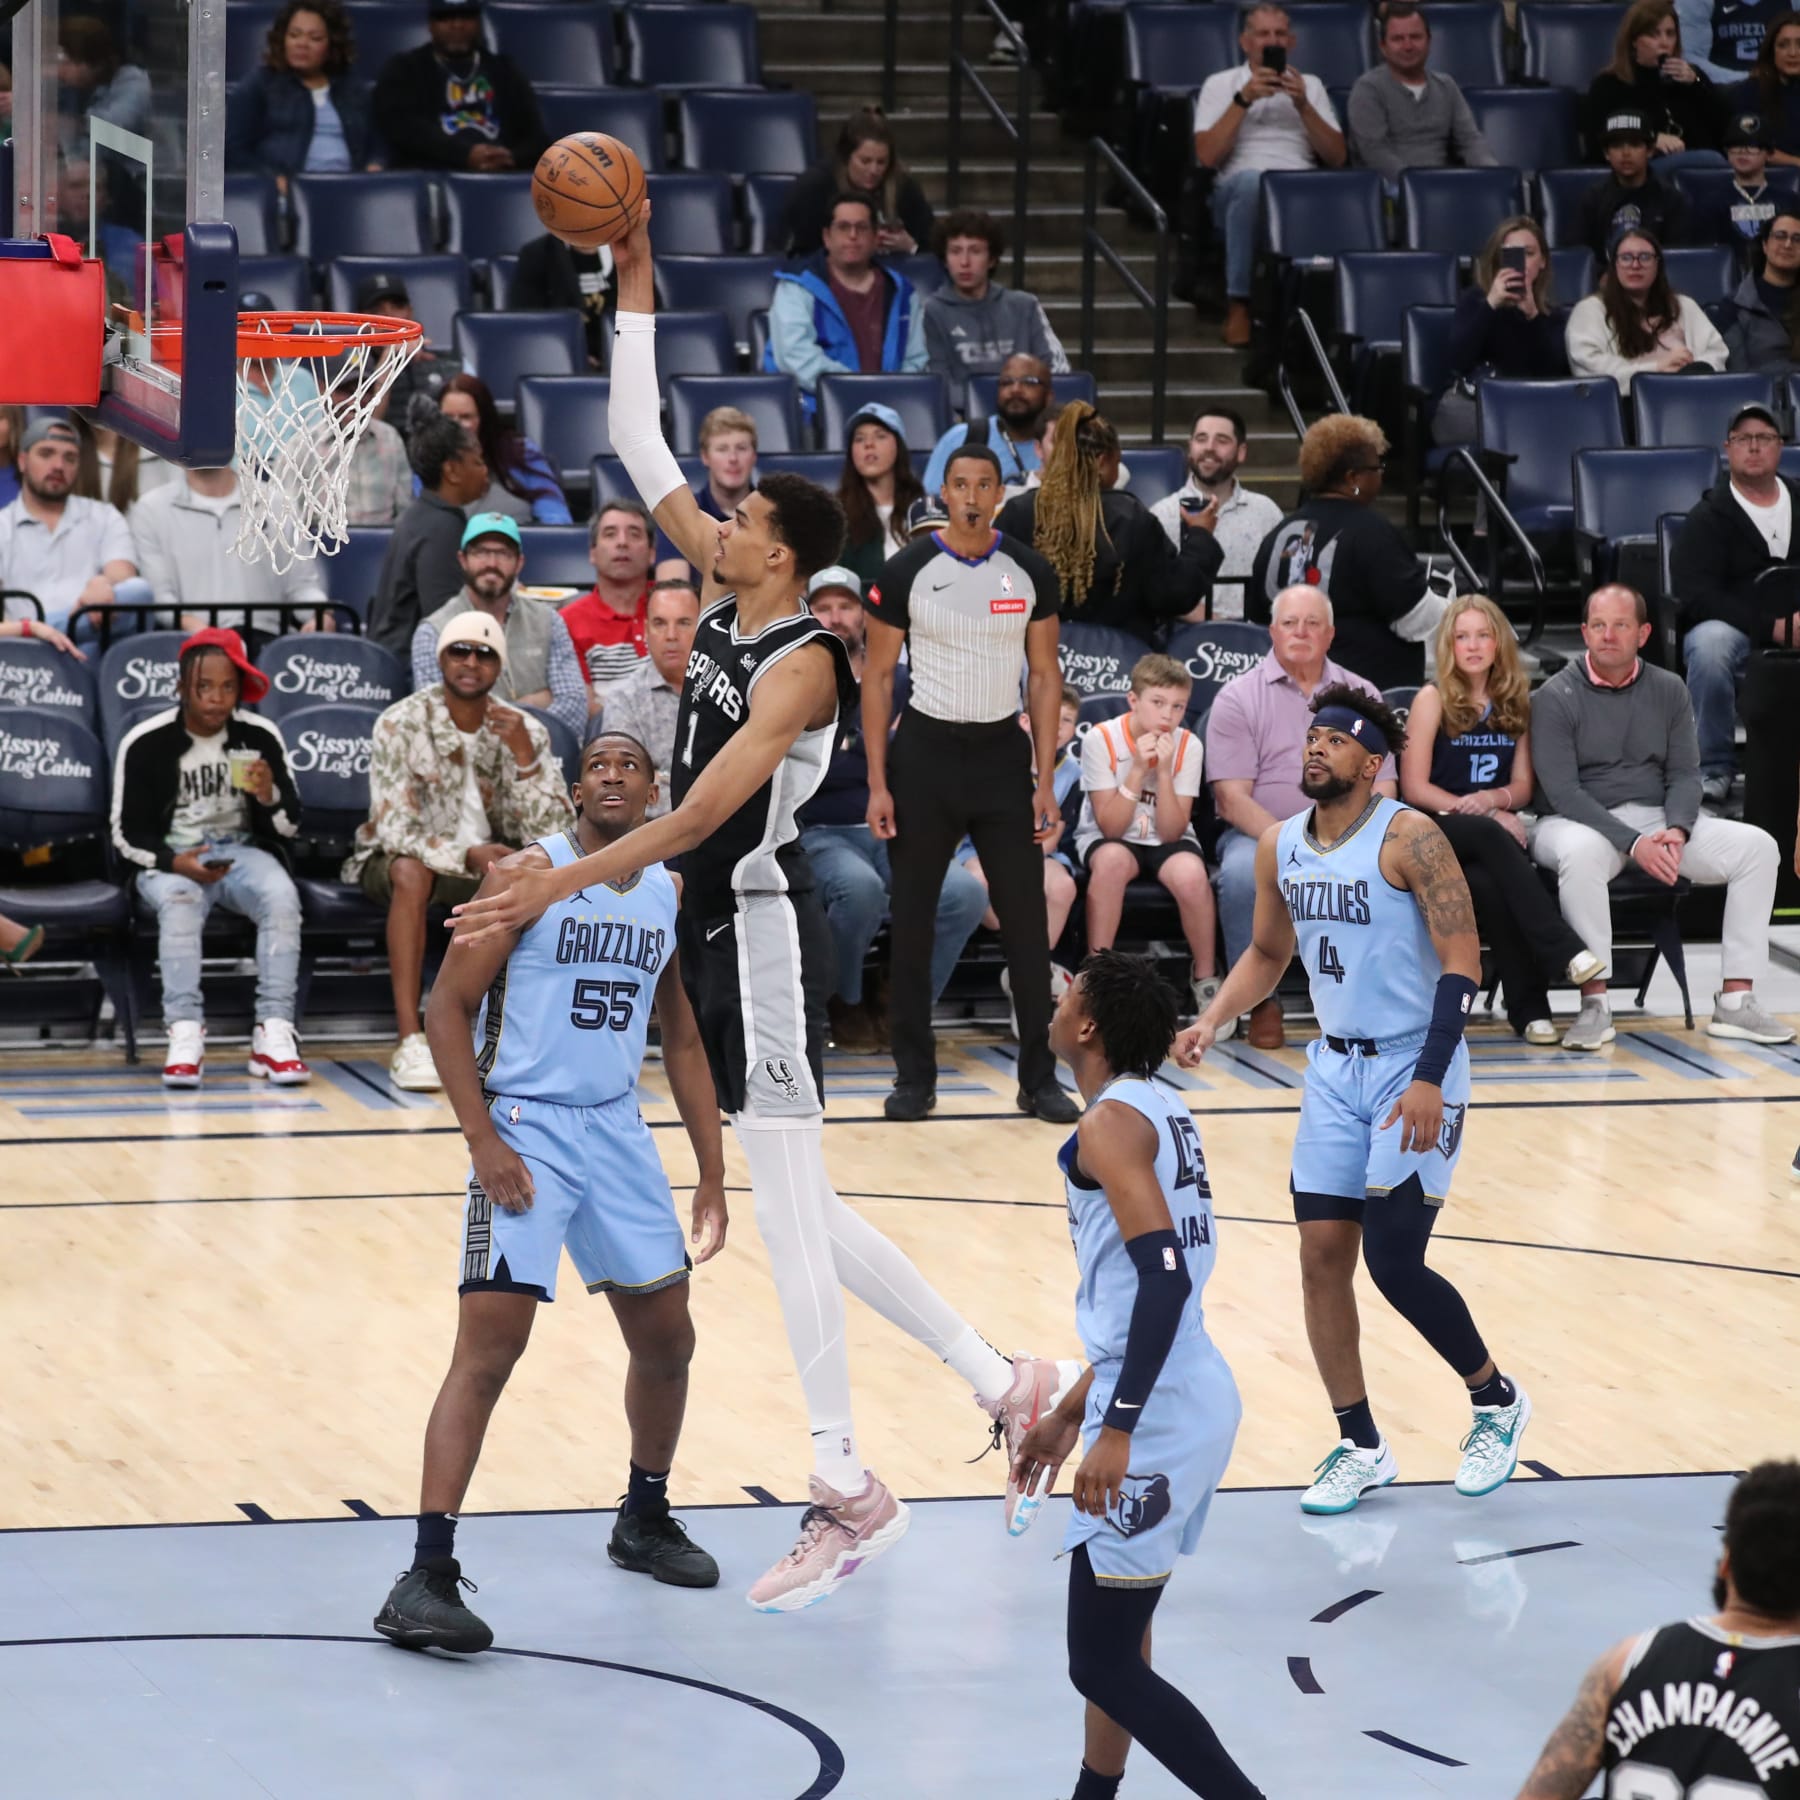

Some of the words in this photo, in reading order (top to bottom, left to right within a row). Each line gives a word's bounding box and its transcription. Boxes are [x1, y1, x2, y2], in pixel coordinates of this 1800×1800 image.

[0, 661, 54, 689] issy's
[274, 654, 361, 693] Sissy's
[306, 677, 338, 702] Log
[340, 680, 391, 700] Cabin
[686, 650, 743, 722] SPURS
[1065, 668, 1097, 693] Log
[1099, 673, 1132, 692] Cab
[0, 681, 29, 706] Log
[30, 685, 84, 707] Cabin
[0, 729, 60, 761] issy's
[681, 710, 699, 768] 1
[2, 754, 35, 779] Log
[37, 756, 92, 778] Cabin
[319, 754, 352, 778] Log
[1470, 754, 1499, 783] 12
[556, 917, 665, 975] GRIZZLIES
[1319, 936, 1346, 984] 4
[570, 979, 641, 1032] 55
[1606, 1681, 1800, 1781] CHAMPAGNIE
